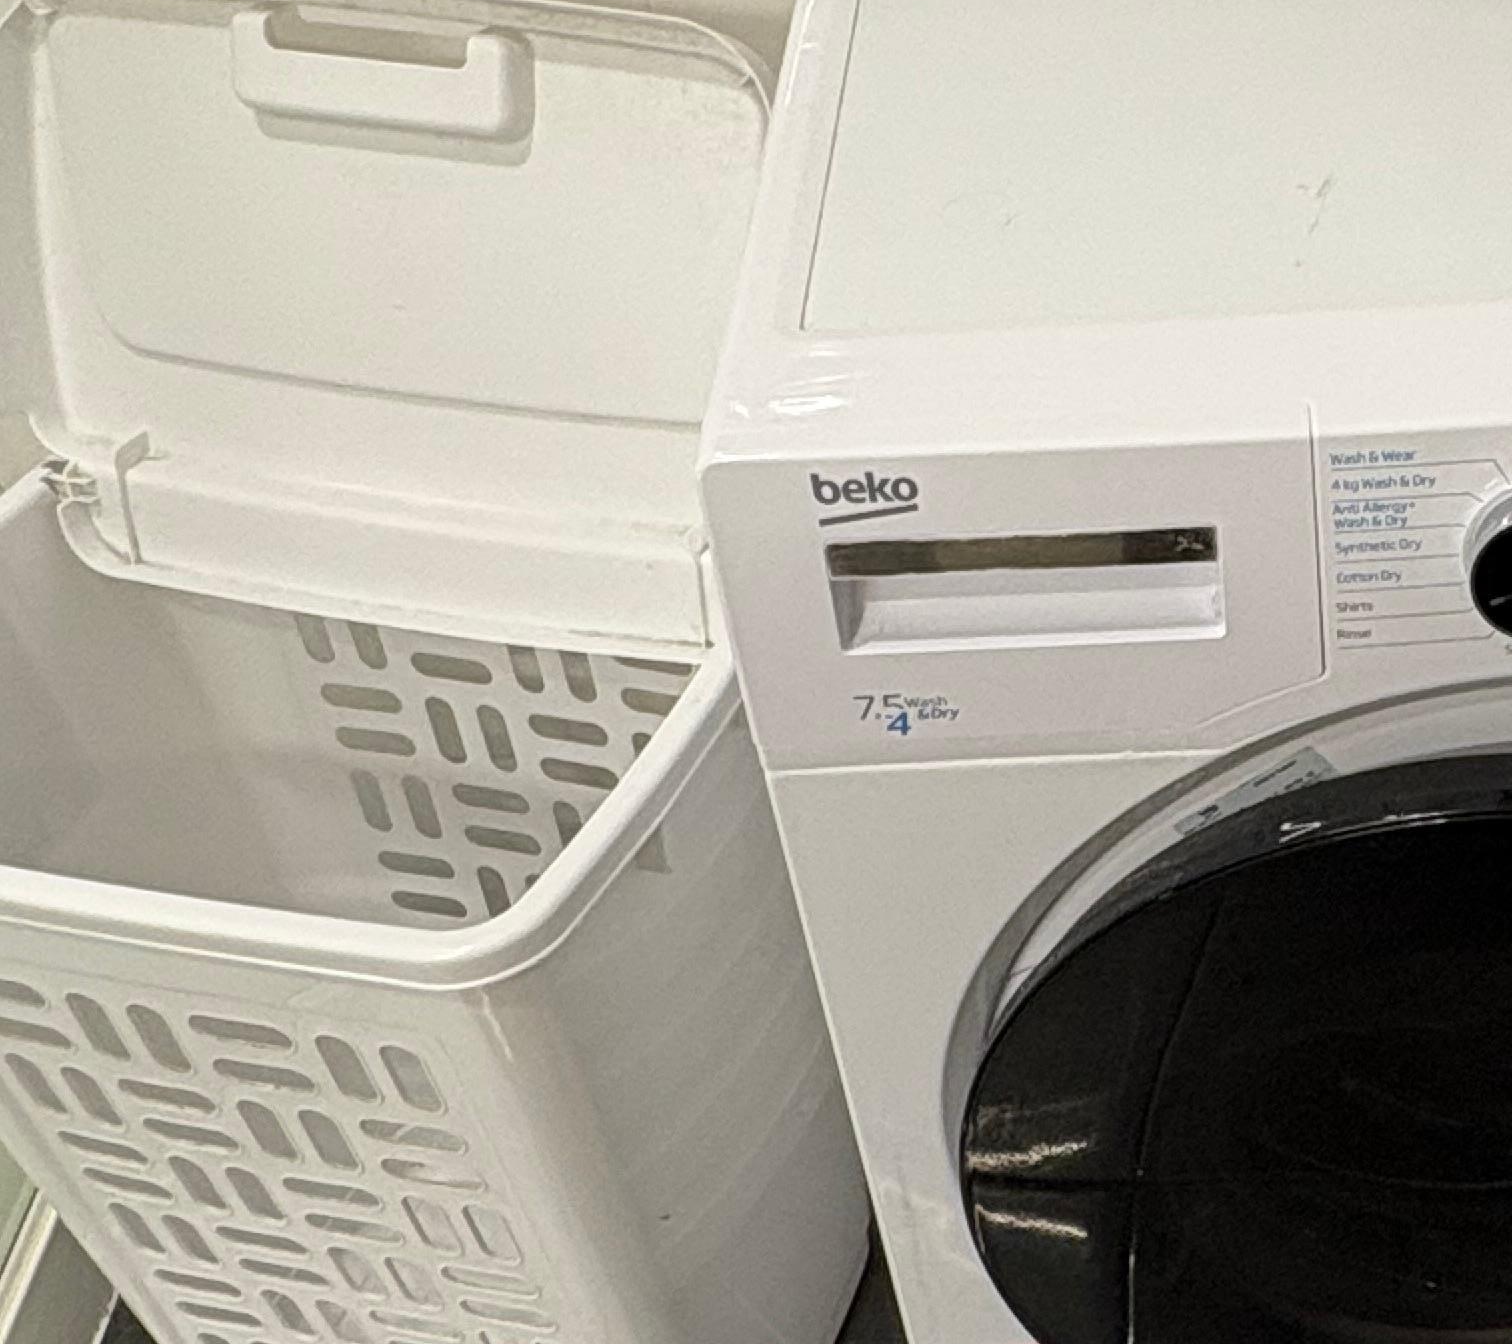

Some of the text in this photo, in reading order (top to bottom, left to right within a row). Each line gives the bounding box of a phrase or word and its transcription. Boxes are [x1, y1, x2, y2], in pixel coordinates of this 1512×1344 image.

[1329, 449, 1417, 466] Wash & Wear
[809, 471, 919, 506] beko
[1331, 478, 1341, 490] 4
[1360, 475, 1398, 490] Wash
[1399, 474, 1410, 488] &
[1412, 474, 1436, 489] Dry
[1333, 501, 1360, 515] Anti
[1334, 516, 1370, 530] Wash
[1384, 514, 1408, 529] Dry
[1335, 538, 1423, 556] Synthetic Dry
[1336, 569, 1402, 584] Cotton Dry
[1336, 602, 1374, 613] Shirts
[886, 711, 912, 736] 4
